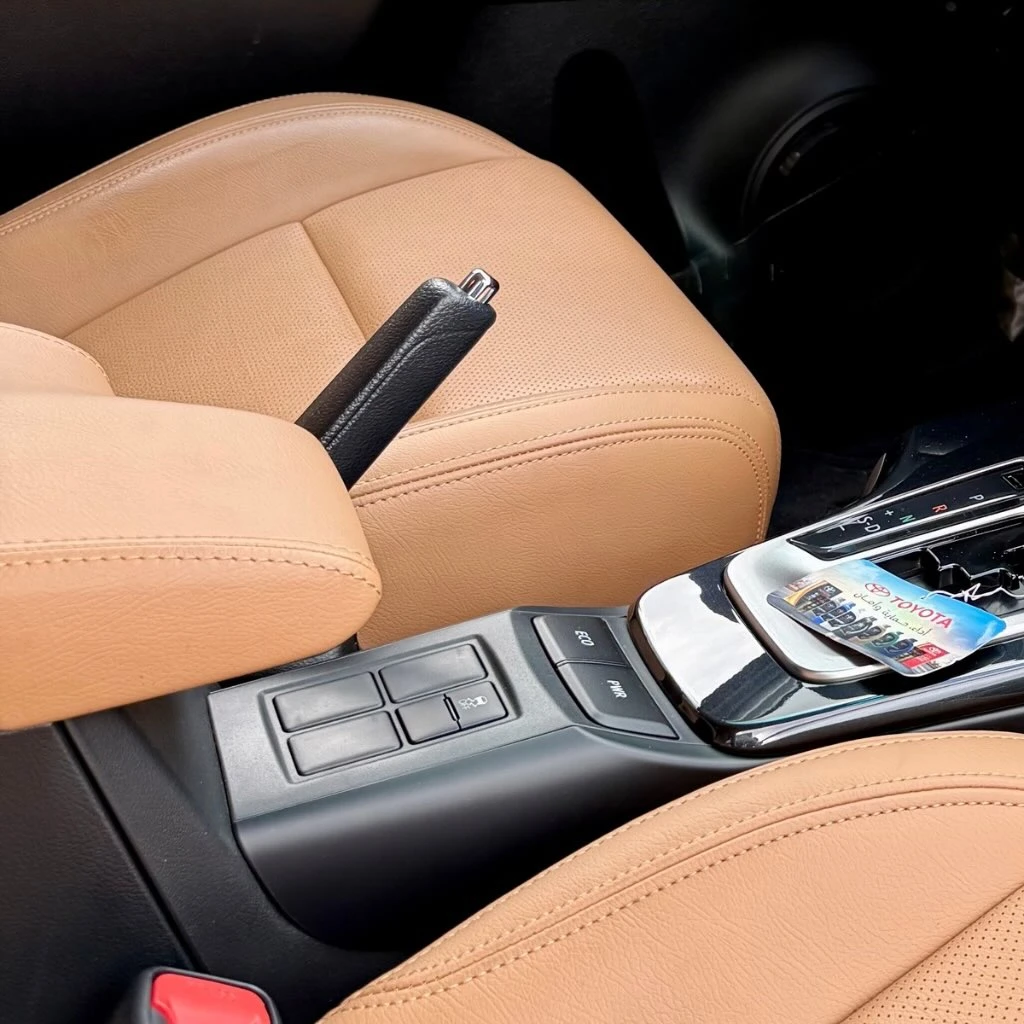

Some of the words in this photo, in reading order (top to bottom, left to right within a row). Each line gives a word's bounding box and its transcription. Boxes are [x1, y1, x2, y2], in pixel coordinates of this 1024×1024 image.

[932, 504, 948, 513] R
[899, 514, 916, 523] N
[889, 595, 953, 629] TOYOTA
[574, 629, 595, 647] ECO
[606, 679, 628, 698] PWR
